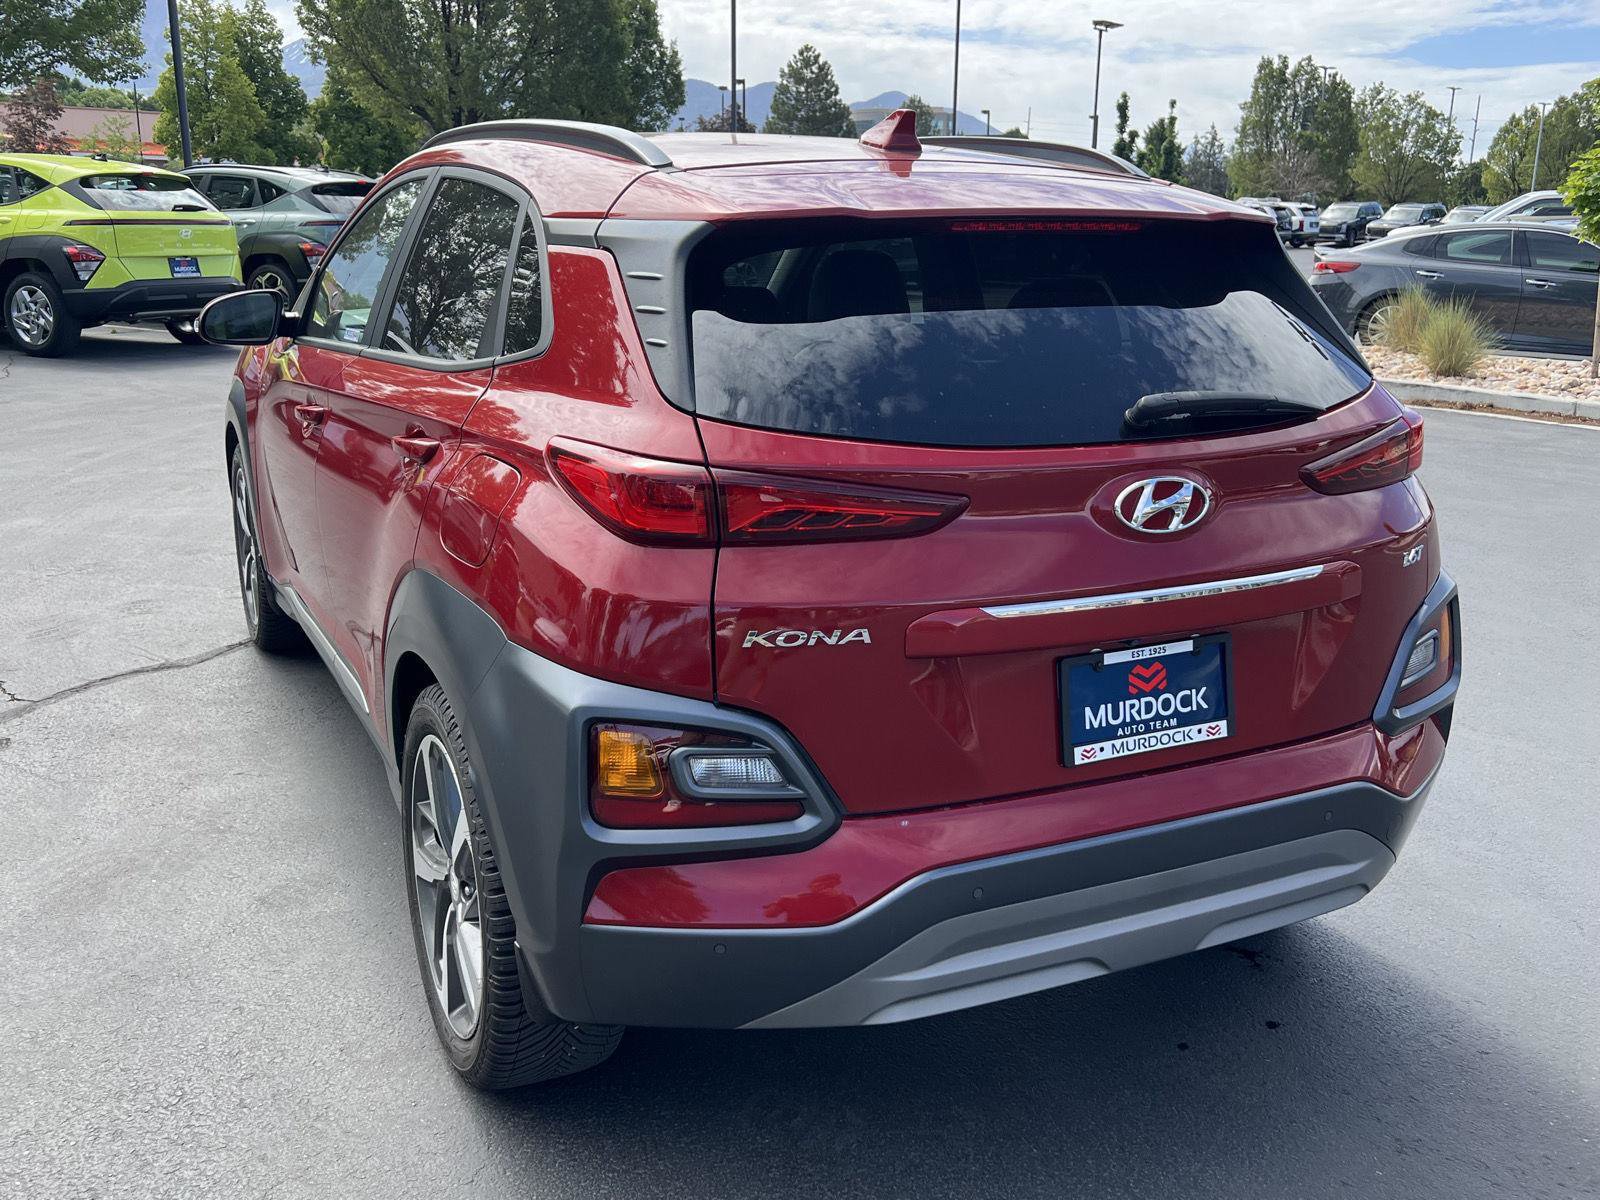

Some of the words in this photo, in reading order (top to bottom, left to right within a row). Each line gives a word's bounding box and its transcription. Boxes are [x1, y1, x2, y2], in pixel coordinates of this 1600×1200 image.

[742, 628, 872, 648] KONA
[1131, 648, 1147, 659] EST.
[1148, 646, 1167, 656] 1925
[1084, 686, 1208, 730] MURDOCK
[1117, 724, 1145, 736] AUTO
[1150, 718, 1178, 731] TEAM
[1111, 728, 1194, 755] MURDOCK
